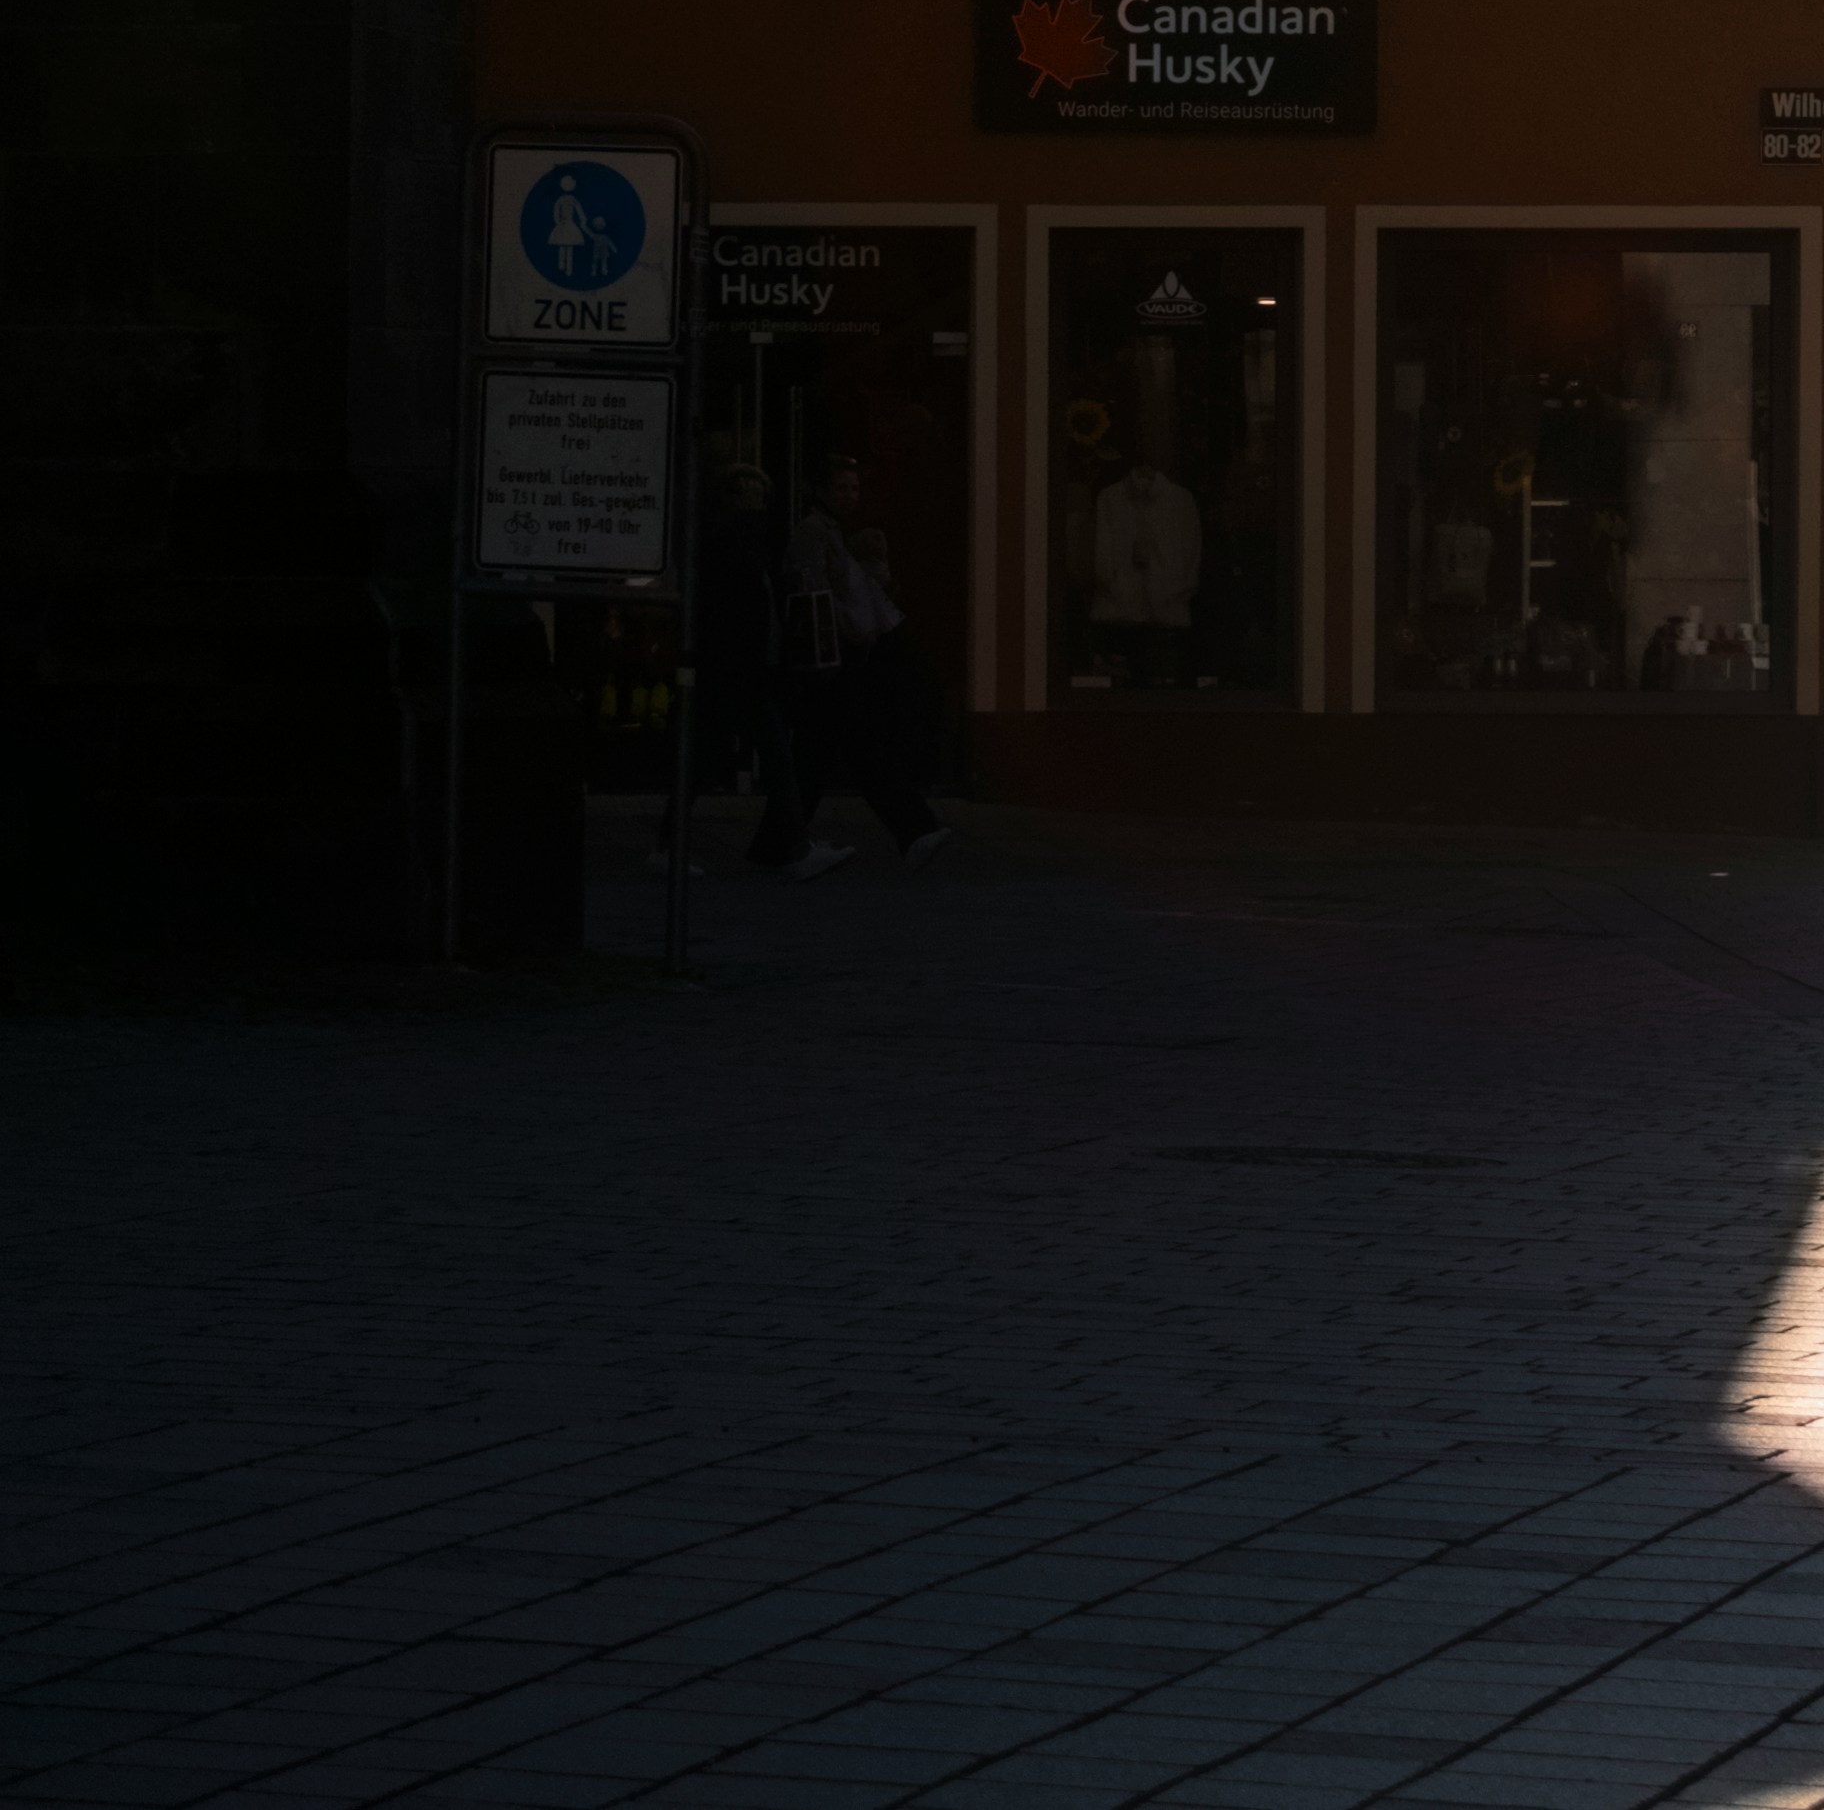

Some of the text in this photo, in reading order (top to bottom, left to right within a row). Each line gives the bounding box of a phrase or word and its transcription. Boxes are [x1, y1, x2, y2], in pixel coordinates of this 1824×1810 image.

[1126, 41, 1276, 98] Husky
[1057, 100, 1336, 124] Wander- und Reiseausrüstung
[1763, 133, 1822, 159] 80-82
[713, 235, 881, 268] Canadian
[720, 273, 835, 317] Husky
[533, 299, 627, 332] ZONE
[527, 389, 627, 409] Zufahrt zu den
[508, 412, 644, 433] privaten Stellplätzen
[560, 435, 591, 451] frei
[561, 468, 650, 489] Lieferverkehr
[487, 489, 506, 504] bis
[547, 519, 571, 533] von
[618, 518, 642, 535] Uhr
[557, 538, 588, 555] frei
